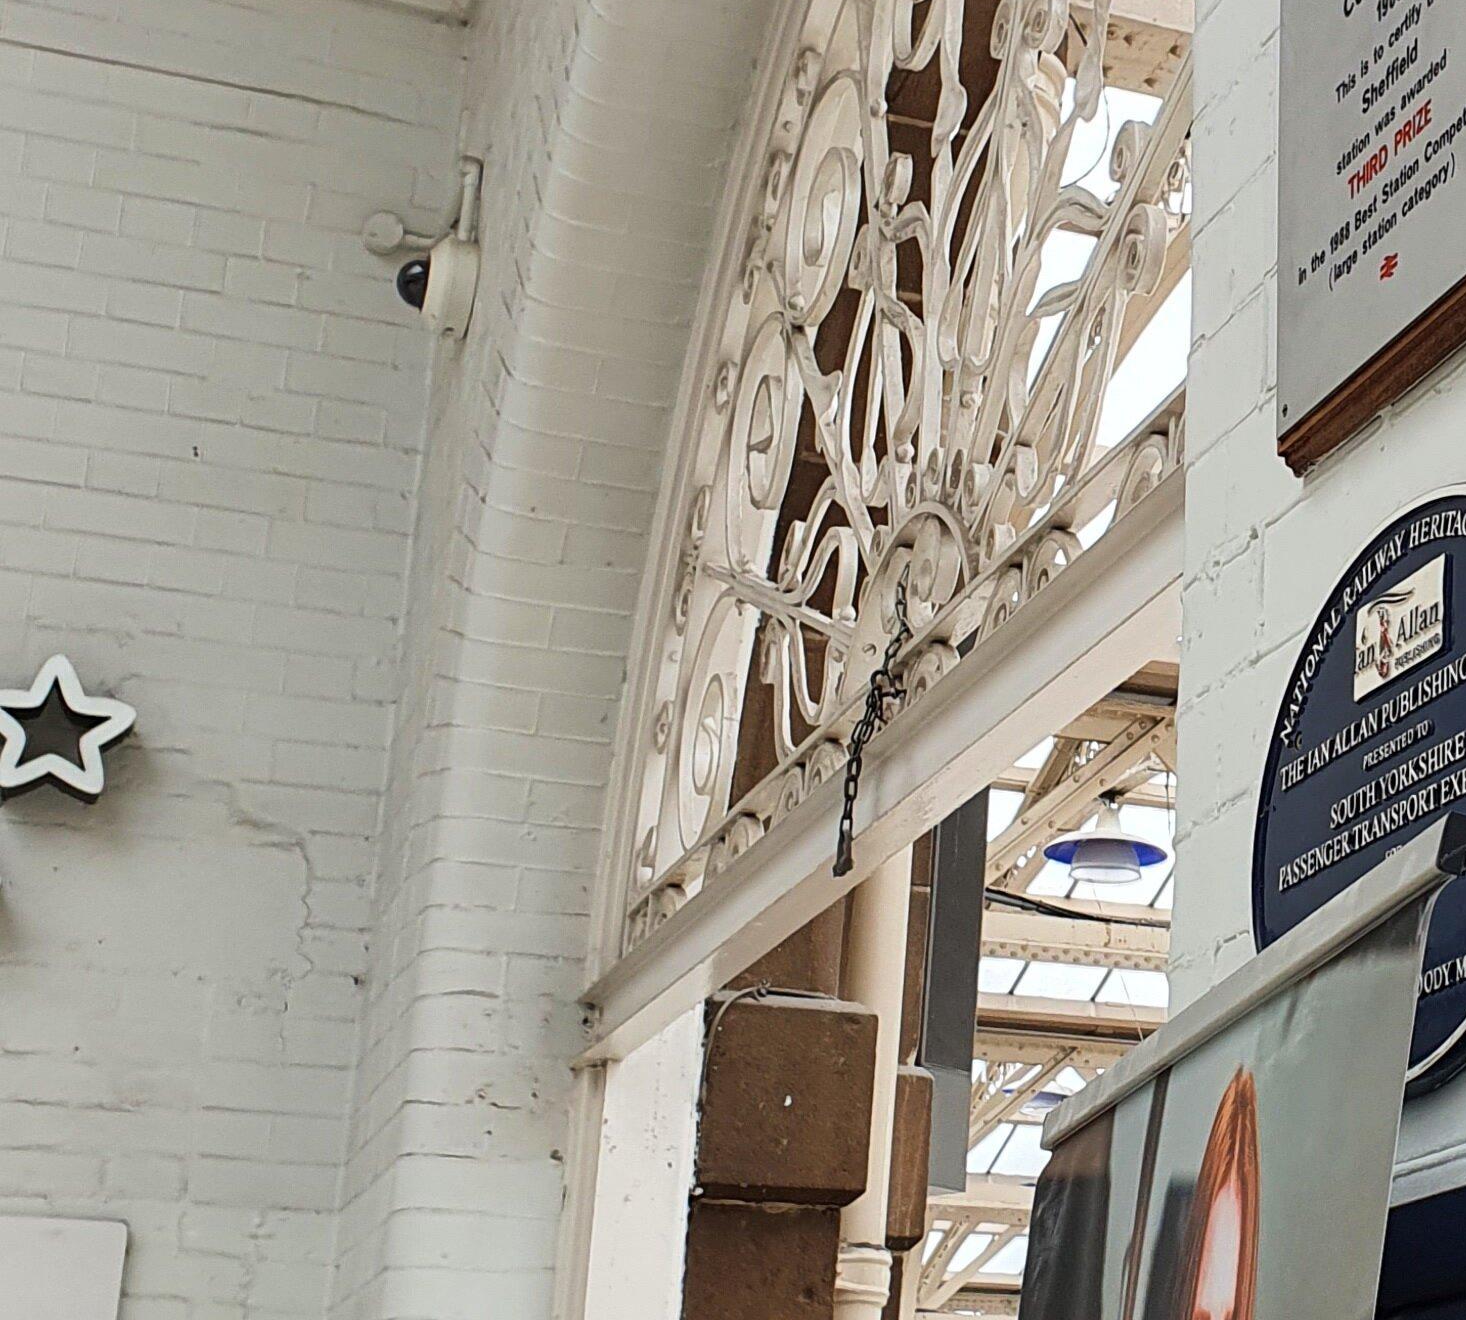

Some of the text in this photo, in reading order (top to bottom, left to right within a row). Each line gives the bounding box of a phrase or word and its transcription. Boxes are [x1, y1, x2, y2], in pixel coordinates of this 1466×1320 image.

[1335, 72, 1356, 104] This
[1360, 60, 1369, 78] is
[1373, 44, 1384, 64] to
[1388, 2, 1422, 48] certify
[1361, 37, 1419, 114] Sheffield
[1336, 48, 1447, 175] station was awarded
[1347, 98, 1433, 200] THIRD PRIZE
[1298, 267, 1307, 286] in
[1311, 249, 1326, 274] the
[1329, 220, 1351, 255] 1988
[1354, 194, 1378, 232] Best
[1381, 158, 1420, 204] Station
[1328, 152, 1456, 292] (large station category)
[1280, 607, 1342, 748] NATIONAL
[1342, 529, 1407, 609] RAILWAY
[1395, 601, 1441, 648] Allan
[1280, 758, 1305, 791] THE
[1307, 739, 1331, 775] IAN
[1332, 711, 1379, 760] ALLAN
[1330, 731, 1466, 829] SOUTH YORKSHIRE
[1363, 719, 1430, 771] PRESENTED TO
[1278, 836, 1351, 892] PASSENGER
[1351, 787, 1438, 850] TRANSPORT
